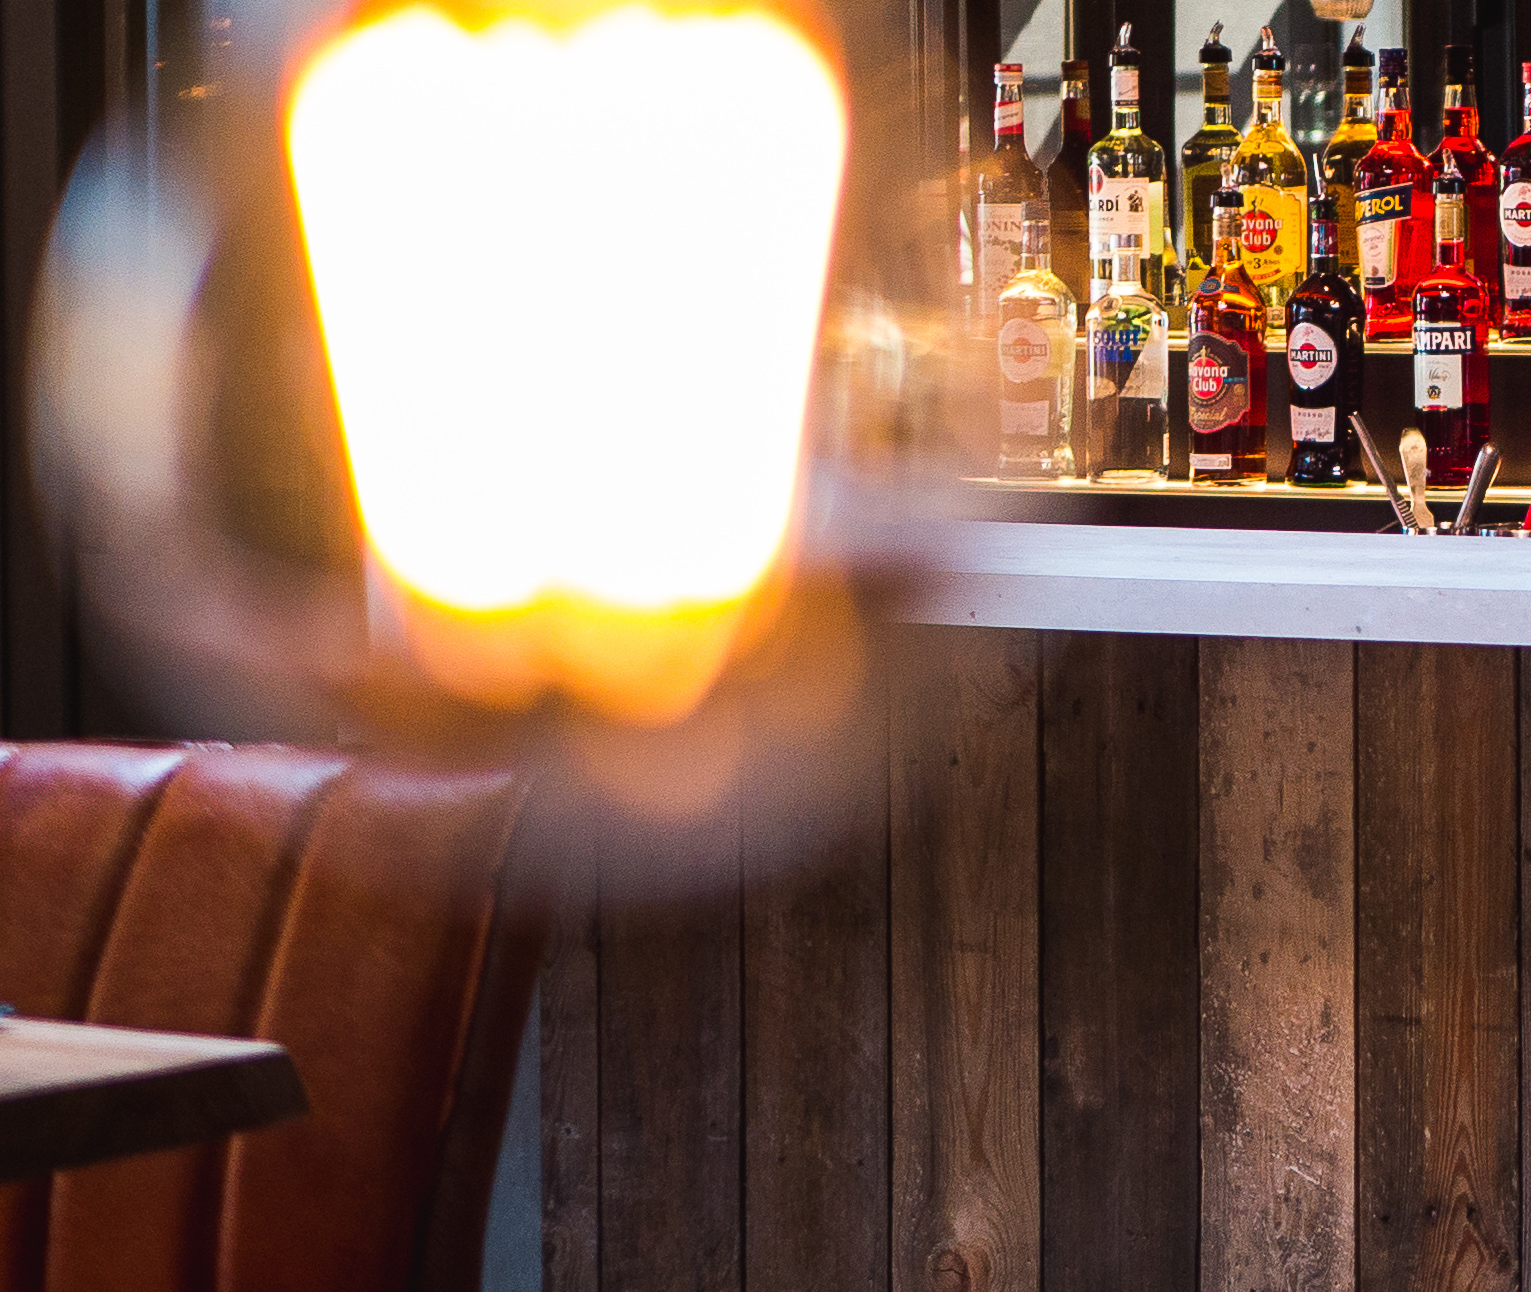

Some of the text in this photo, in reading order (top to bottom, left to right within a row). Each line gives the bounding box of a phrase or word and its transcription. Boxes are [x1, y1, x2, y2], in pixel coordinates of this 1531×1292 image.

[1241, 218, 1284, 230] avana
[1240, 231, 1273, 246] Club
[1253, 257, 1262, 270] 3
[1092, 329, 1141, 346] SOLUT
[1414, 331, 1472, 350] AMPARI
[1290, 349, 1332, 362] MARTINI
[1192, 377, 1218, 392] Club
